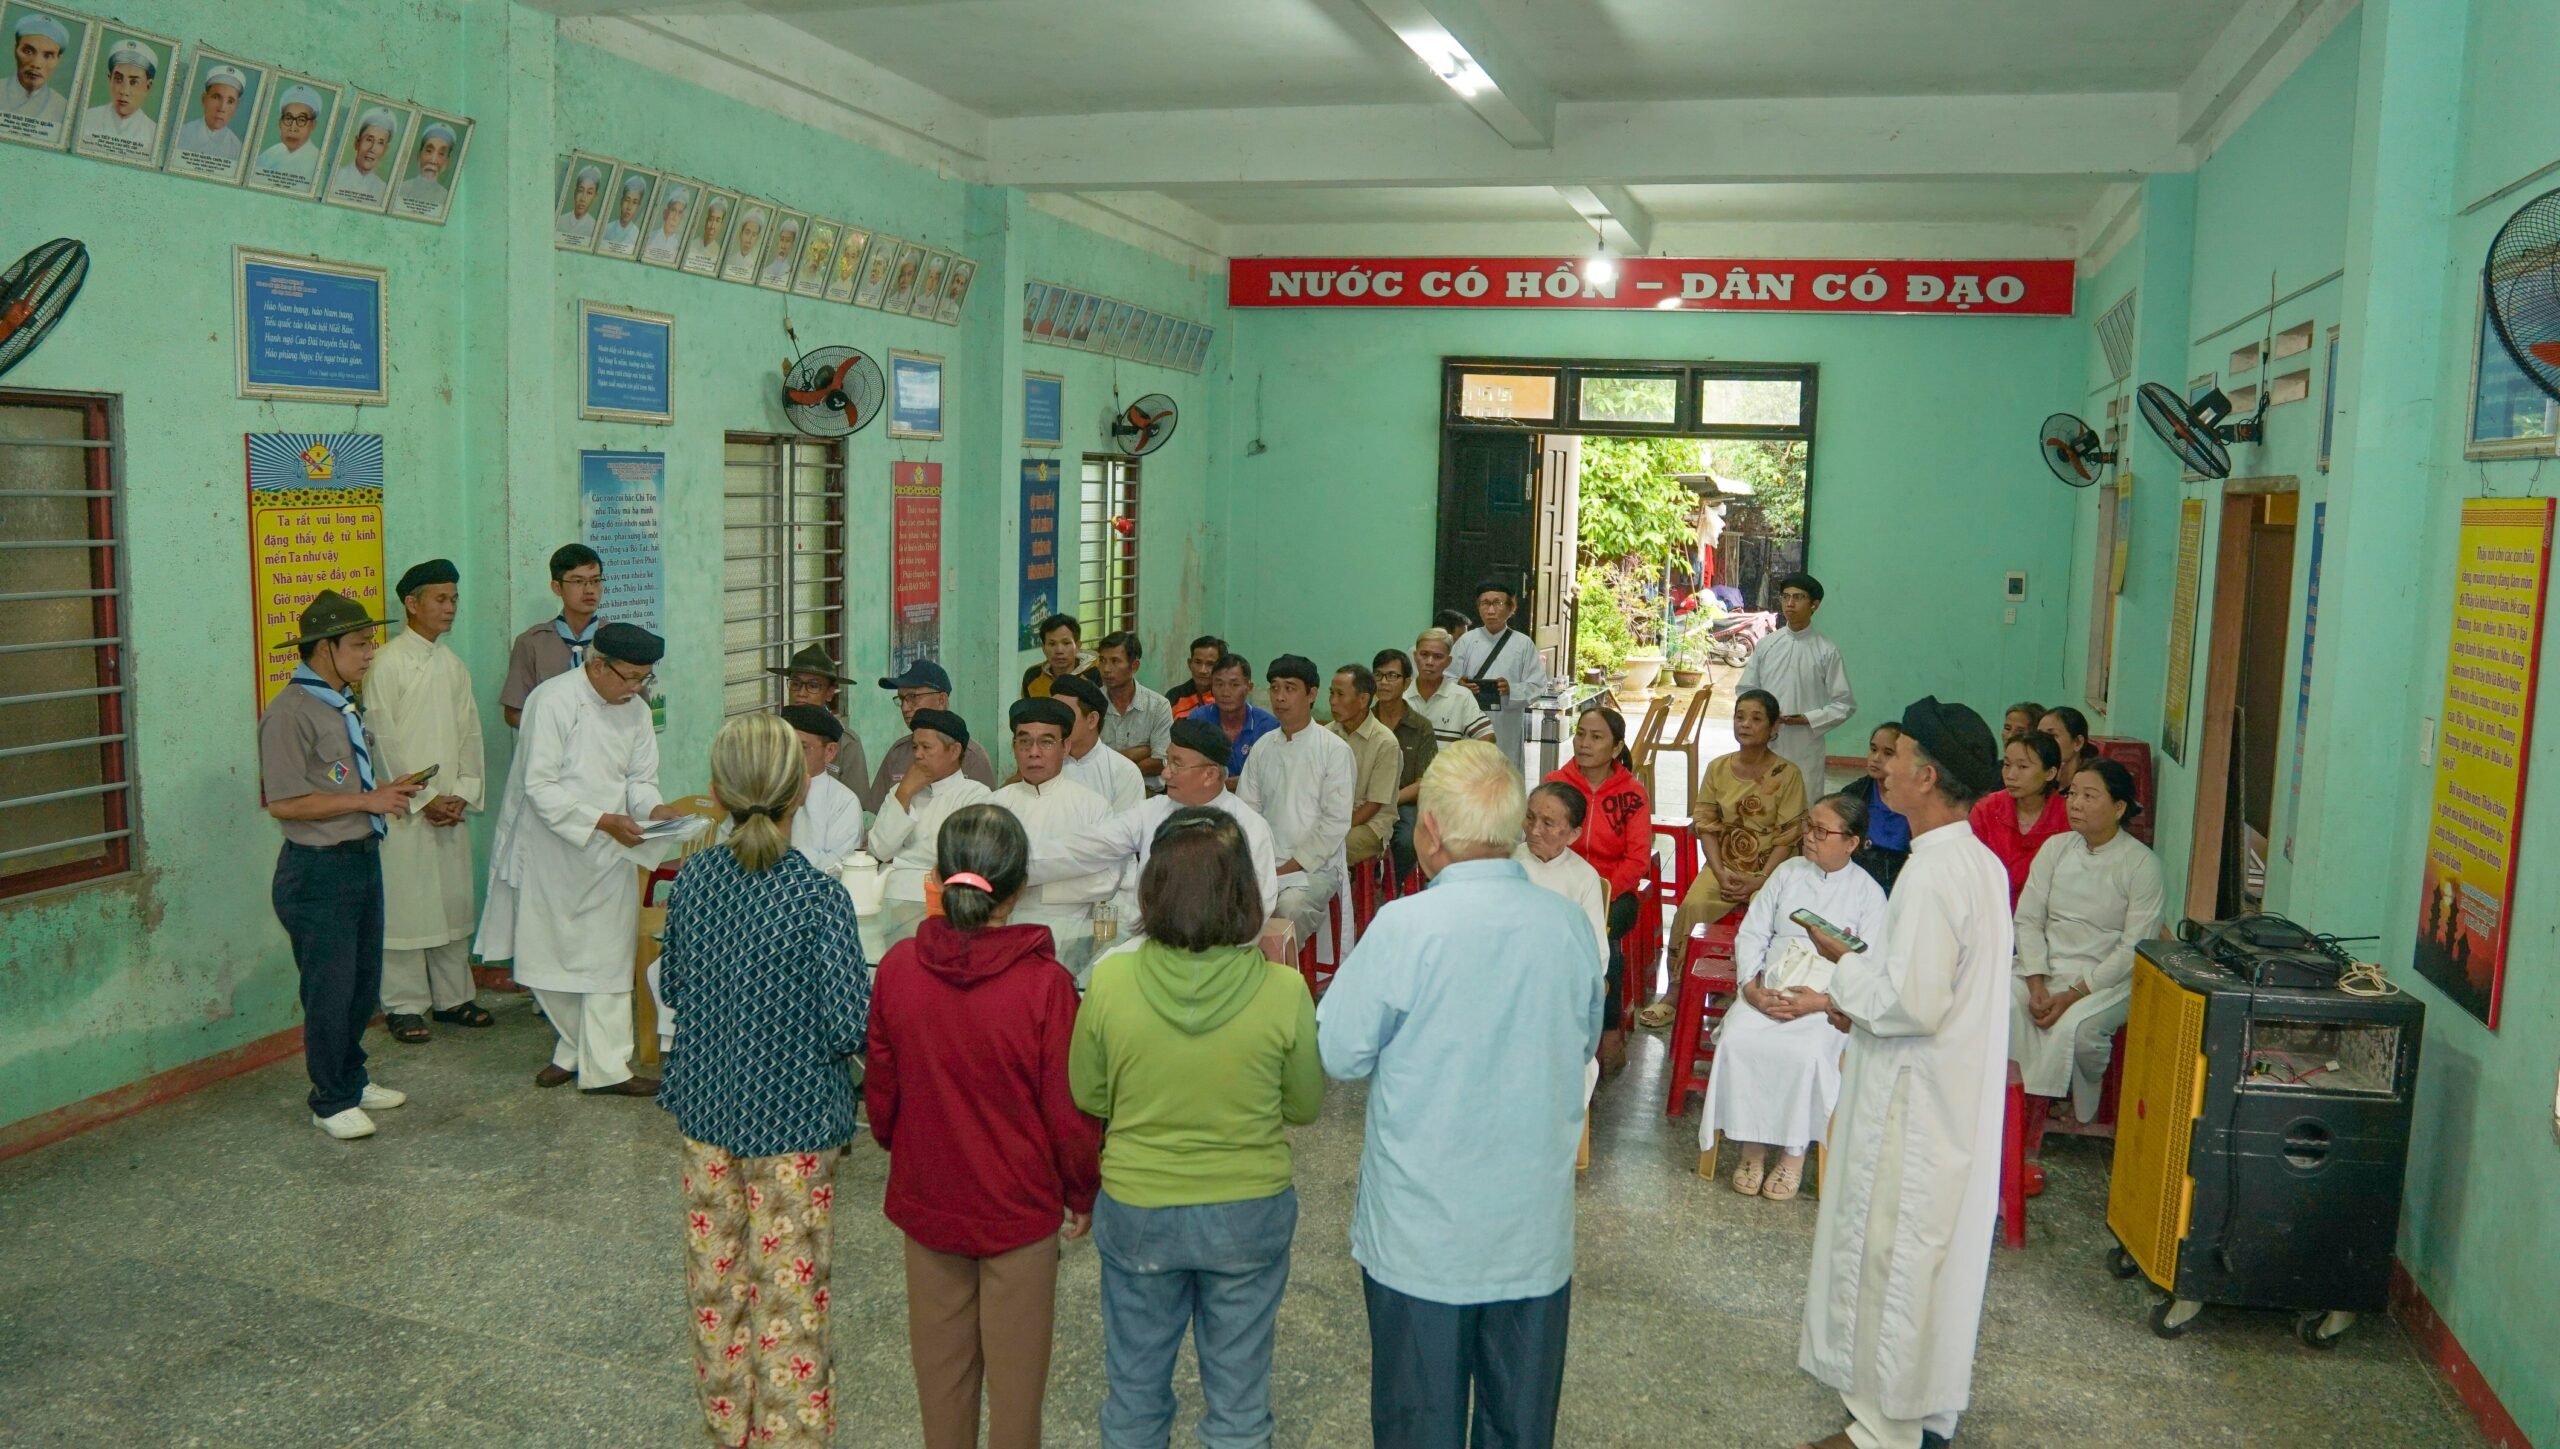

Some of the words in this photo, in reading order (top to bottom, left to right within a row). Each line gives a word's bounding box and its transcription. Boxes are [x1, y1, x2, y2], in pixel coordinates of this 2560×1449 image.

[1269, 265, 1403, 297] NƯỚC
[1420, 265, 1488, 297] CÓ
[1506, 261, 1619, 298] HỒN
[1681, 267, 1794, 300] DÂN
[1812, 268, 1888, 302] CÓ
[1906, 275, 2024, 310] ĐẠO
[278, 515, 289, 526] Ta
[296, 513, 310, 525] rất
[317, 514, 330, 525] vui
[336, 513, 356, 525] lòng
[362, 512, 374, 522] mà
[264, 534, 289, 547] đặng
[295, 531, 316, 545] thấy
[323, 531, 334, 544] đệ
[265, 551, 286, 564] mến
[289, 552, 300, 563] Ta
[303, 551, 321, 562] như
[322, 550, 339, 562] vậy
[273, 573, 292, 584] Nhà
[296, 572, 313, 584] này
[317, 571, 327, 581] sẽ
[330, 567, 346, 581] đầy
[350, 570, 360, 579] ơn
[364, 566, 374, 577] Ta
[274, 593, 290, 605] Giờ
[364, 586, 377, 598] đợi
[267, 613, 285, 626] lịnh
